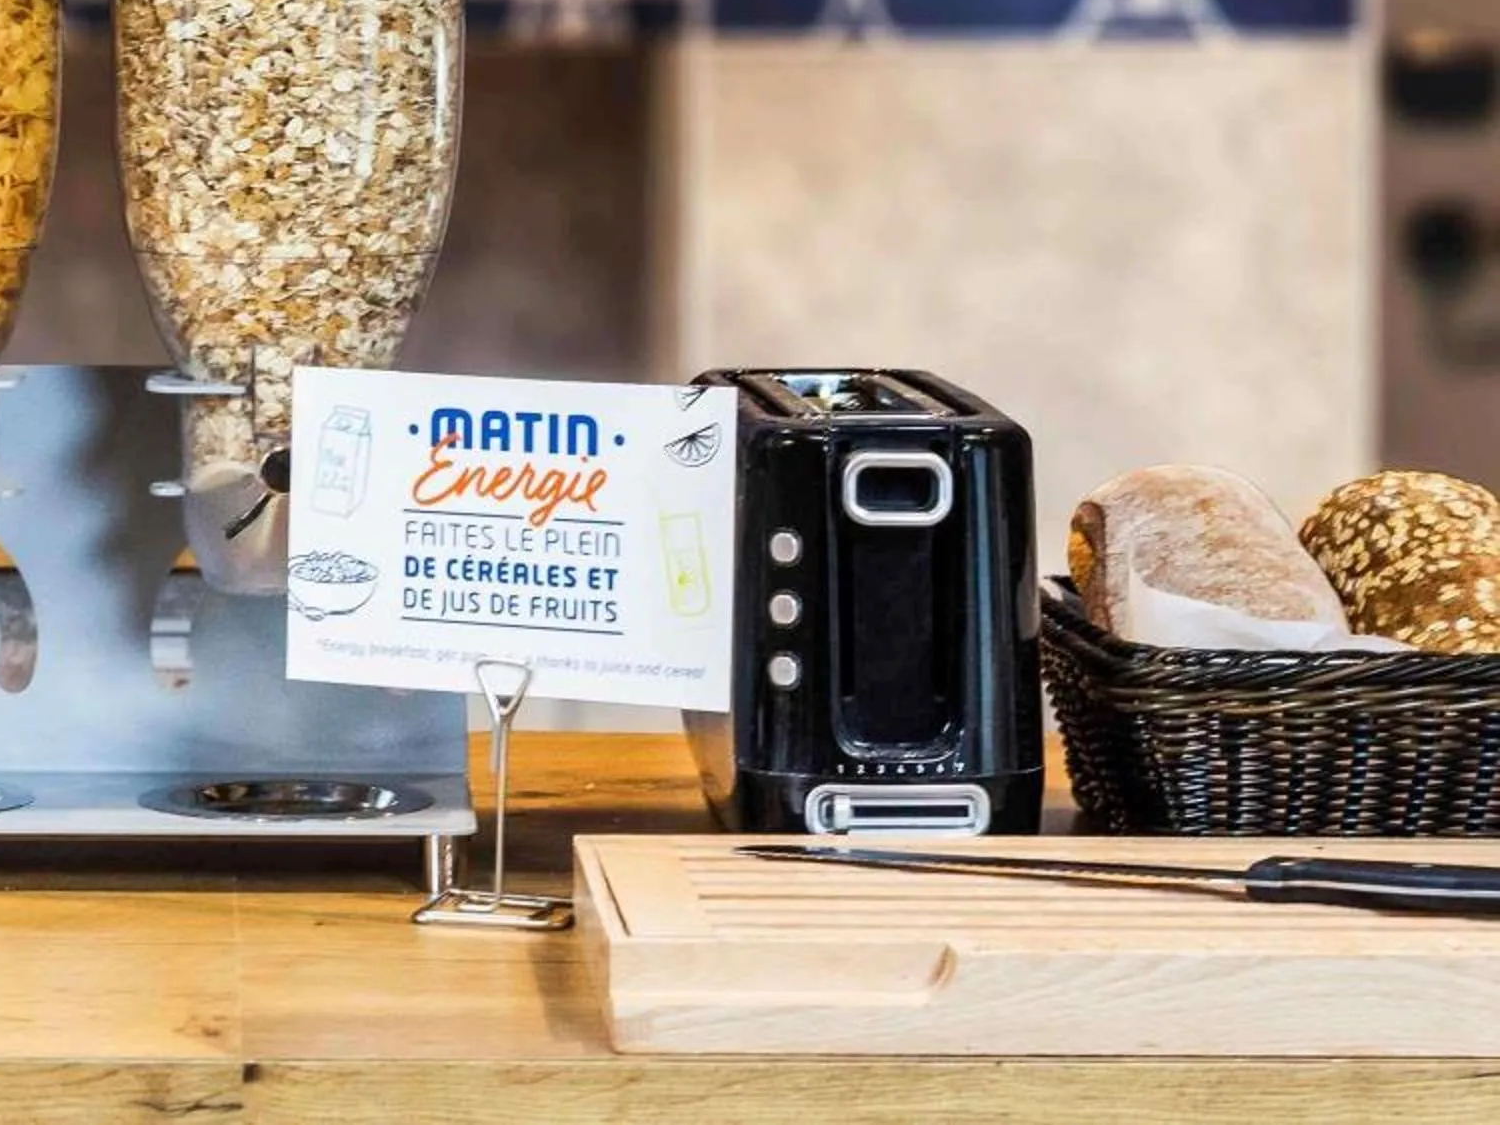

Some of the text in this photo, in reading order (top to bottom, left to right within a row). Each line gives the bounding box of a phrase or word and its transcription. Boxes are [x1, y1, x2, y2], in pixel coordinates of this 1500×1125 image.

[431, 408, 598, 456] MATIN
[404, 520, 621, 557] FAITES LE PLEIN
[404, 554, 619, 591] DE CÉRÉALES ET
[403, 587, 618, 623] DE JUS DE FRUITS
[856, 763, 866, 775] 2
